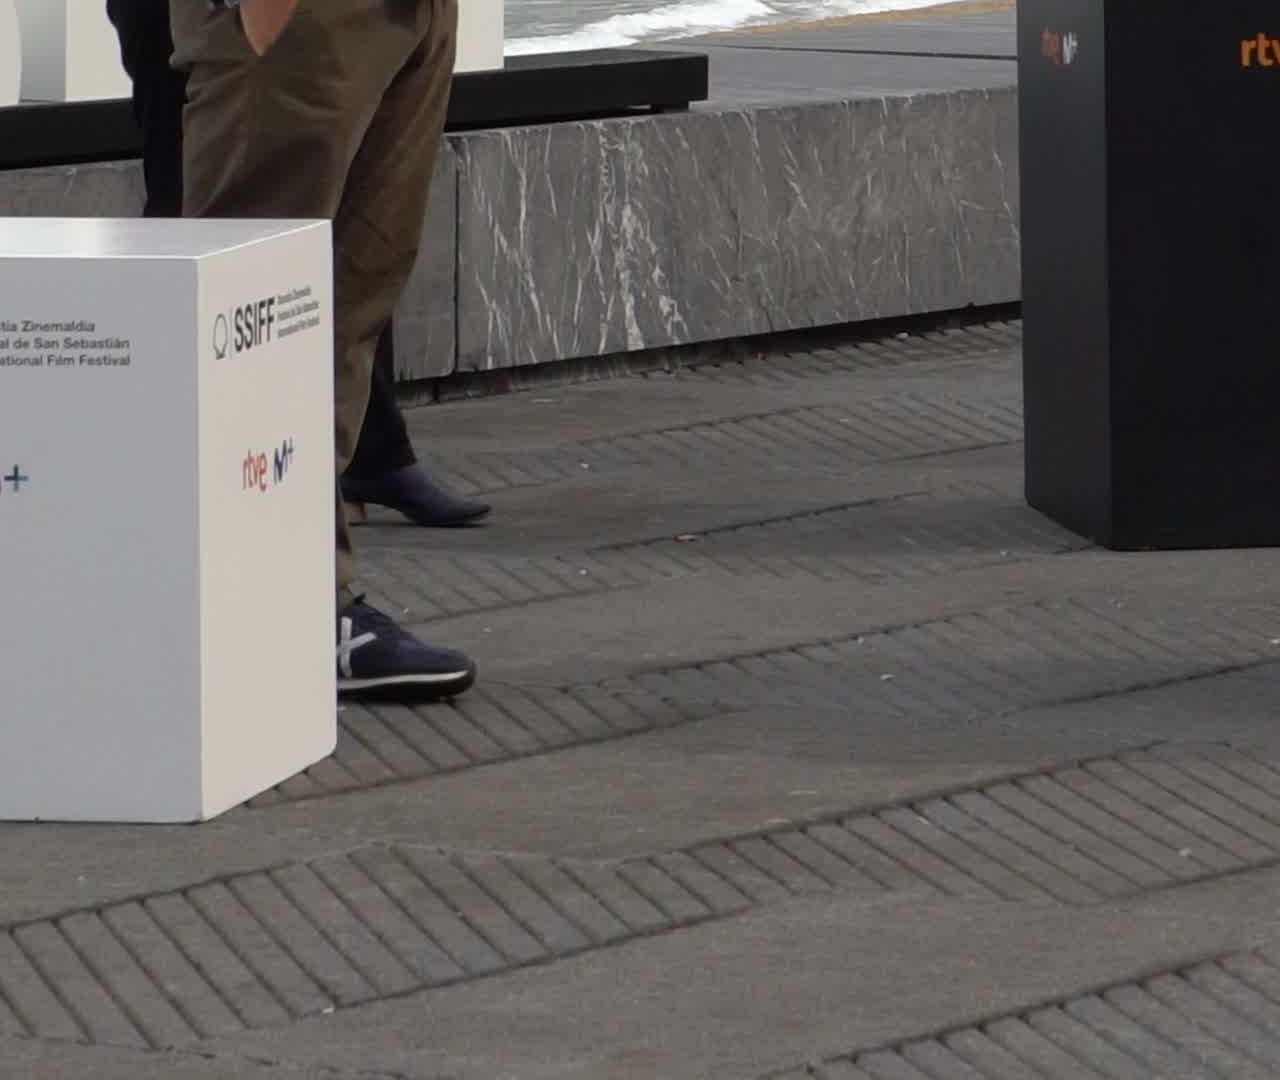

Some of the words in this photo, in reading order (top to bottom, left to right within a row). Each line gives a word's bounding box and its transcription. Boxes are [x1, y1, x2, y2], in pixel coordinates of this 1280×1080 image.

[21, 320, 95, 333] Zinemaldia
[234, 296, 276, 353] SSIFF
[13, 337, 30, 350] de
[33, 337, 59, 350] San
[63, 336, 130, 350] Sebastián
[47, 354, 74, 367] Film
[79, 354, 130, 367] Festival
[242, 448, 268, 492] rtve
